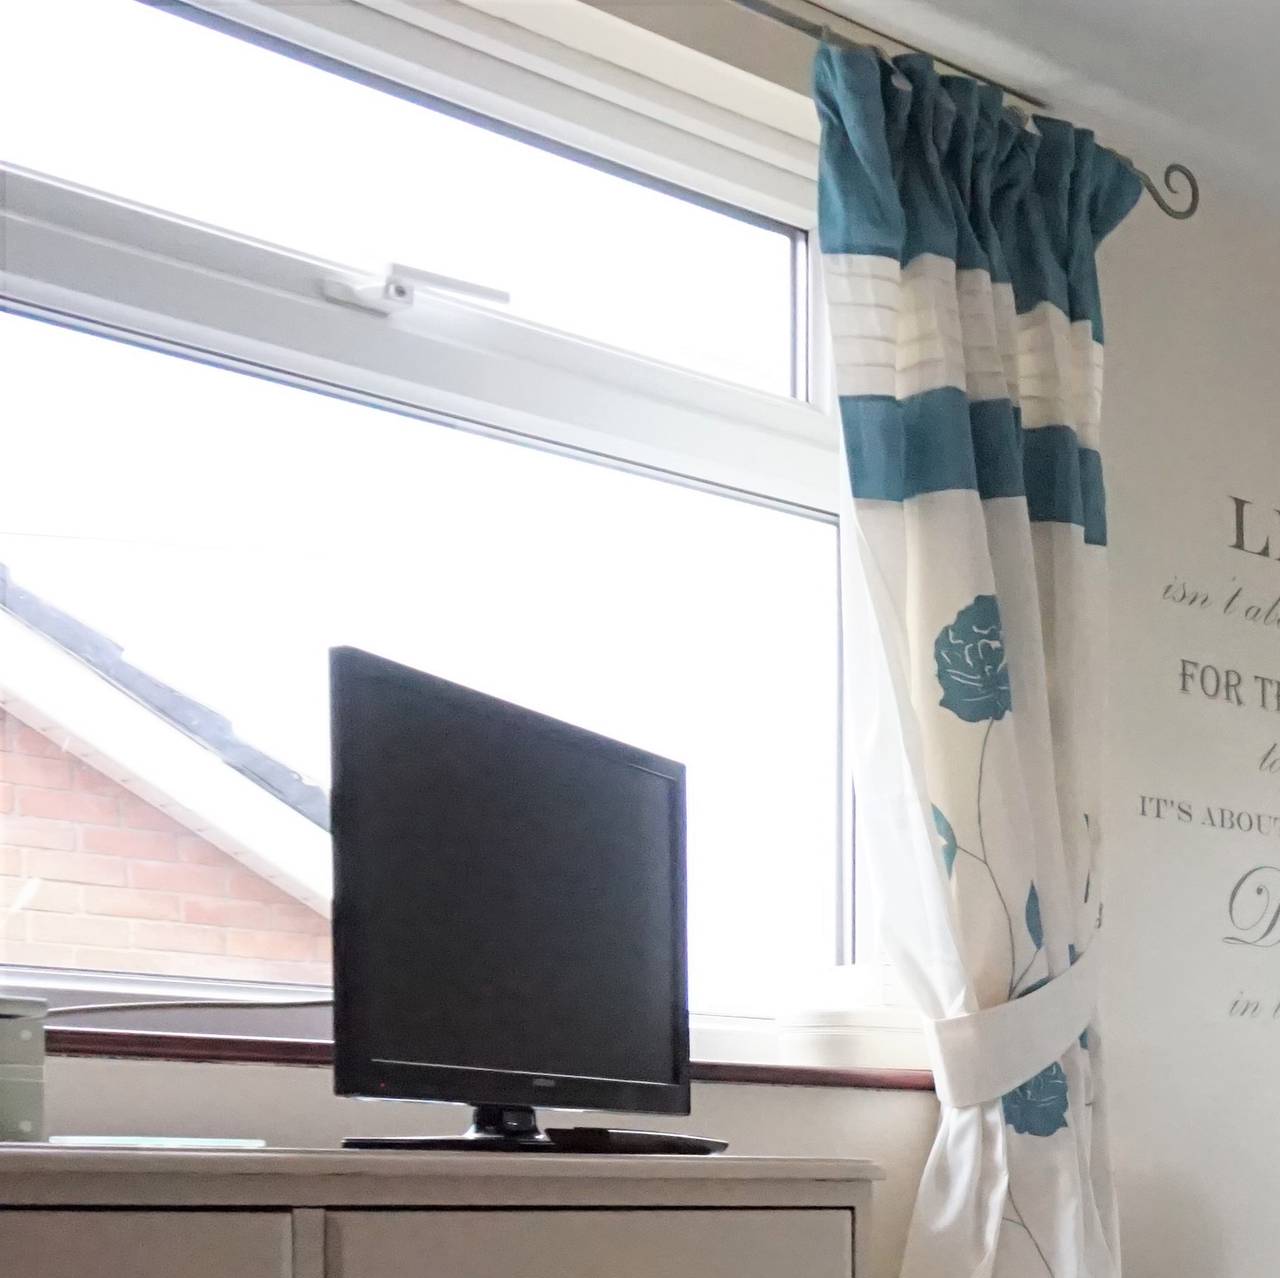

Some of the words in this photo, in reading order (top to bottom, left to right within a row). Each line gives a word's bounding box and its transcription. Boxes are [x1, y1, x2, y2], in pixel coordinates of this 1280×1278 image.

[1162, 576, 1243, 615] isn't
[1178, 658, 1244, 707] FOR
[1138, 795, 1194, 824] IT'S
[1229, 990, 1262, 1018] in
